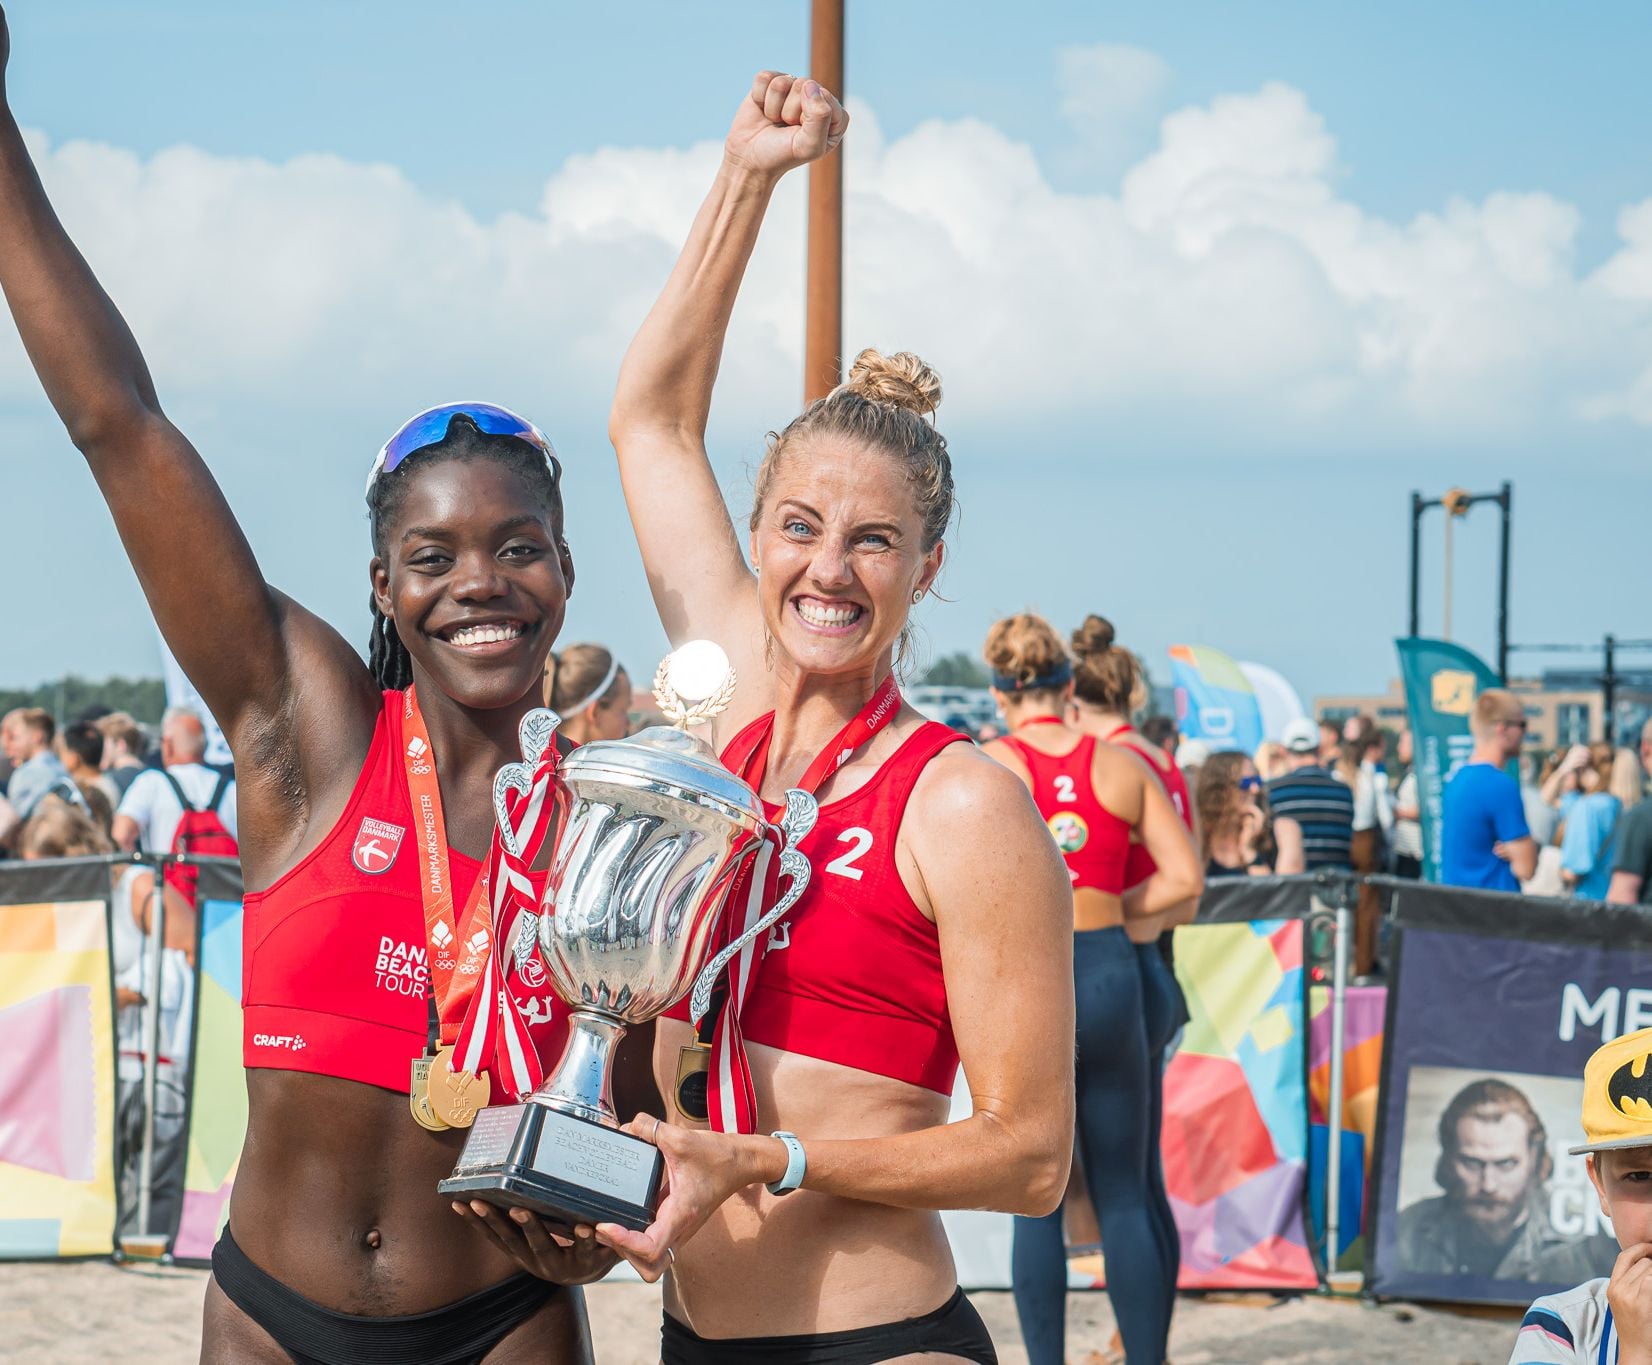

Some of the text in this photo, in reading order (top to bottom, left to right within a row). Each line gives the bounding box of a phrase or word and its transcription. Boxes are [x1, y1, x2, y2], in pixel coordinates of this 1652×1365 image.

[412, 758, 425, 767] DIF
[1053, 774, 1078, 803] 2
[361, 825, 400, 842] DANMARK
[364, 819, 403, 836] VOLLEYBALL
[420, 794, 443, 894] DANMARKSMESTER
[824, 826, 874, 881] 2
[437, 951, 450, 959] DIF
[466, 956, 479, 965] DIF
[375, 954, 430, 984] BEAC
[374, 970, 425, 1000] TOUR
[253, 1033, 294, 1048] CRAFT
[453, 1097, 470, 1109] DIF
